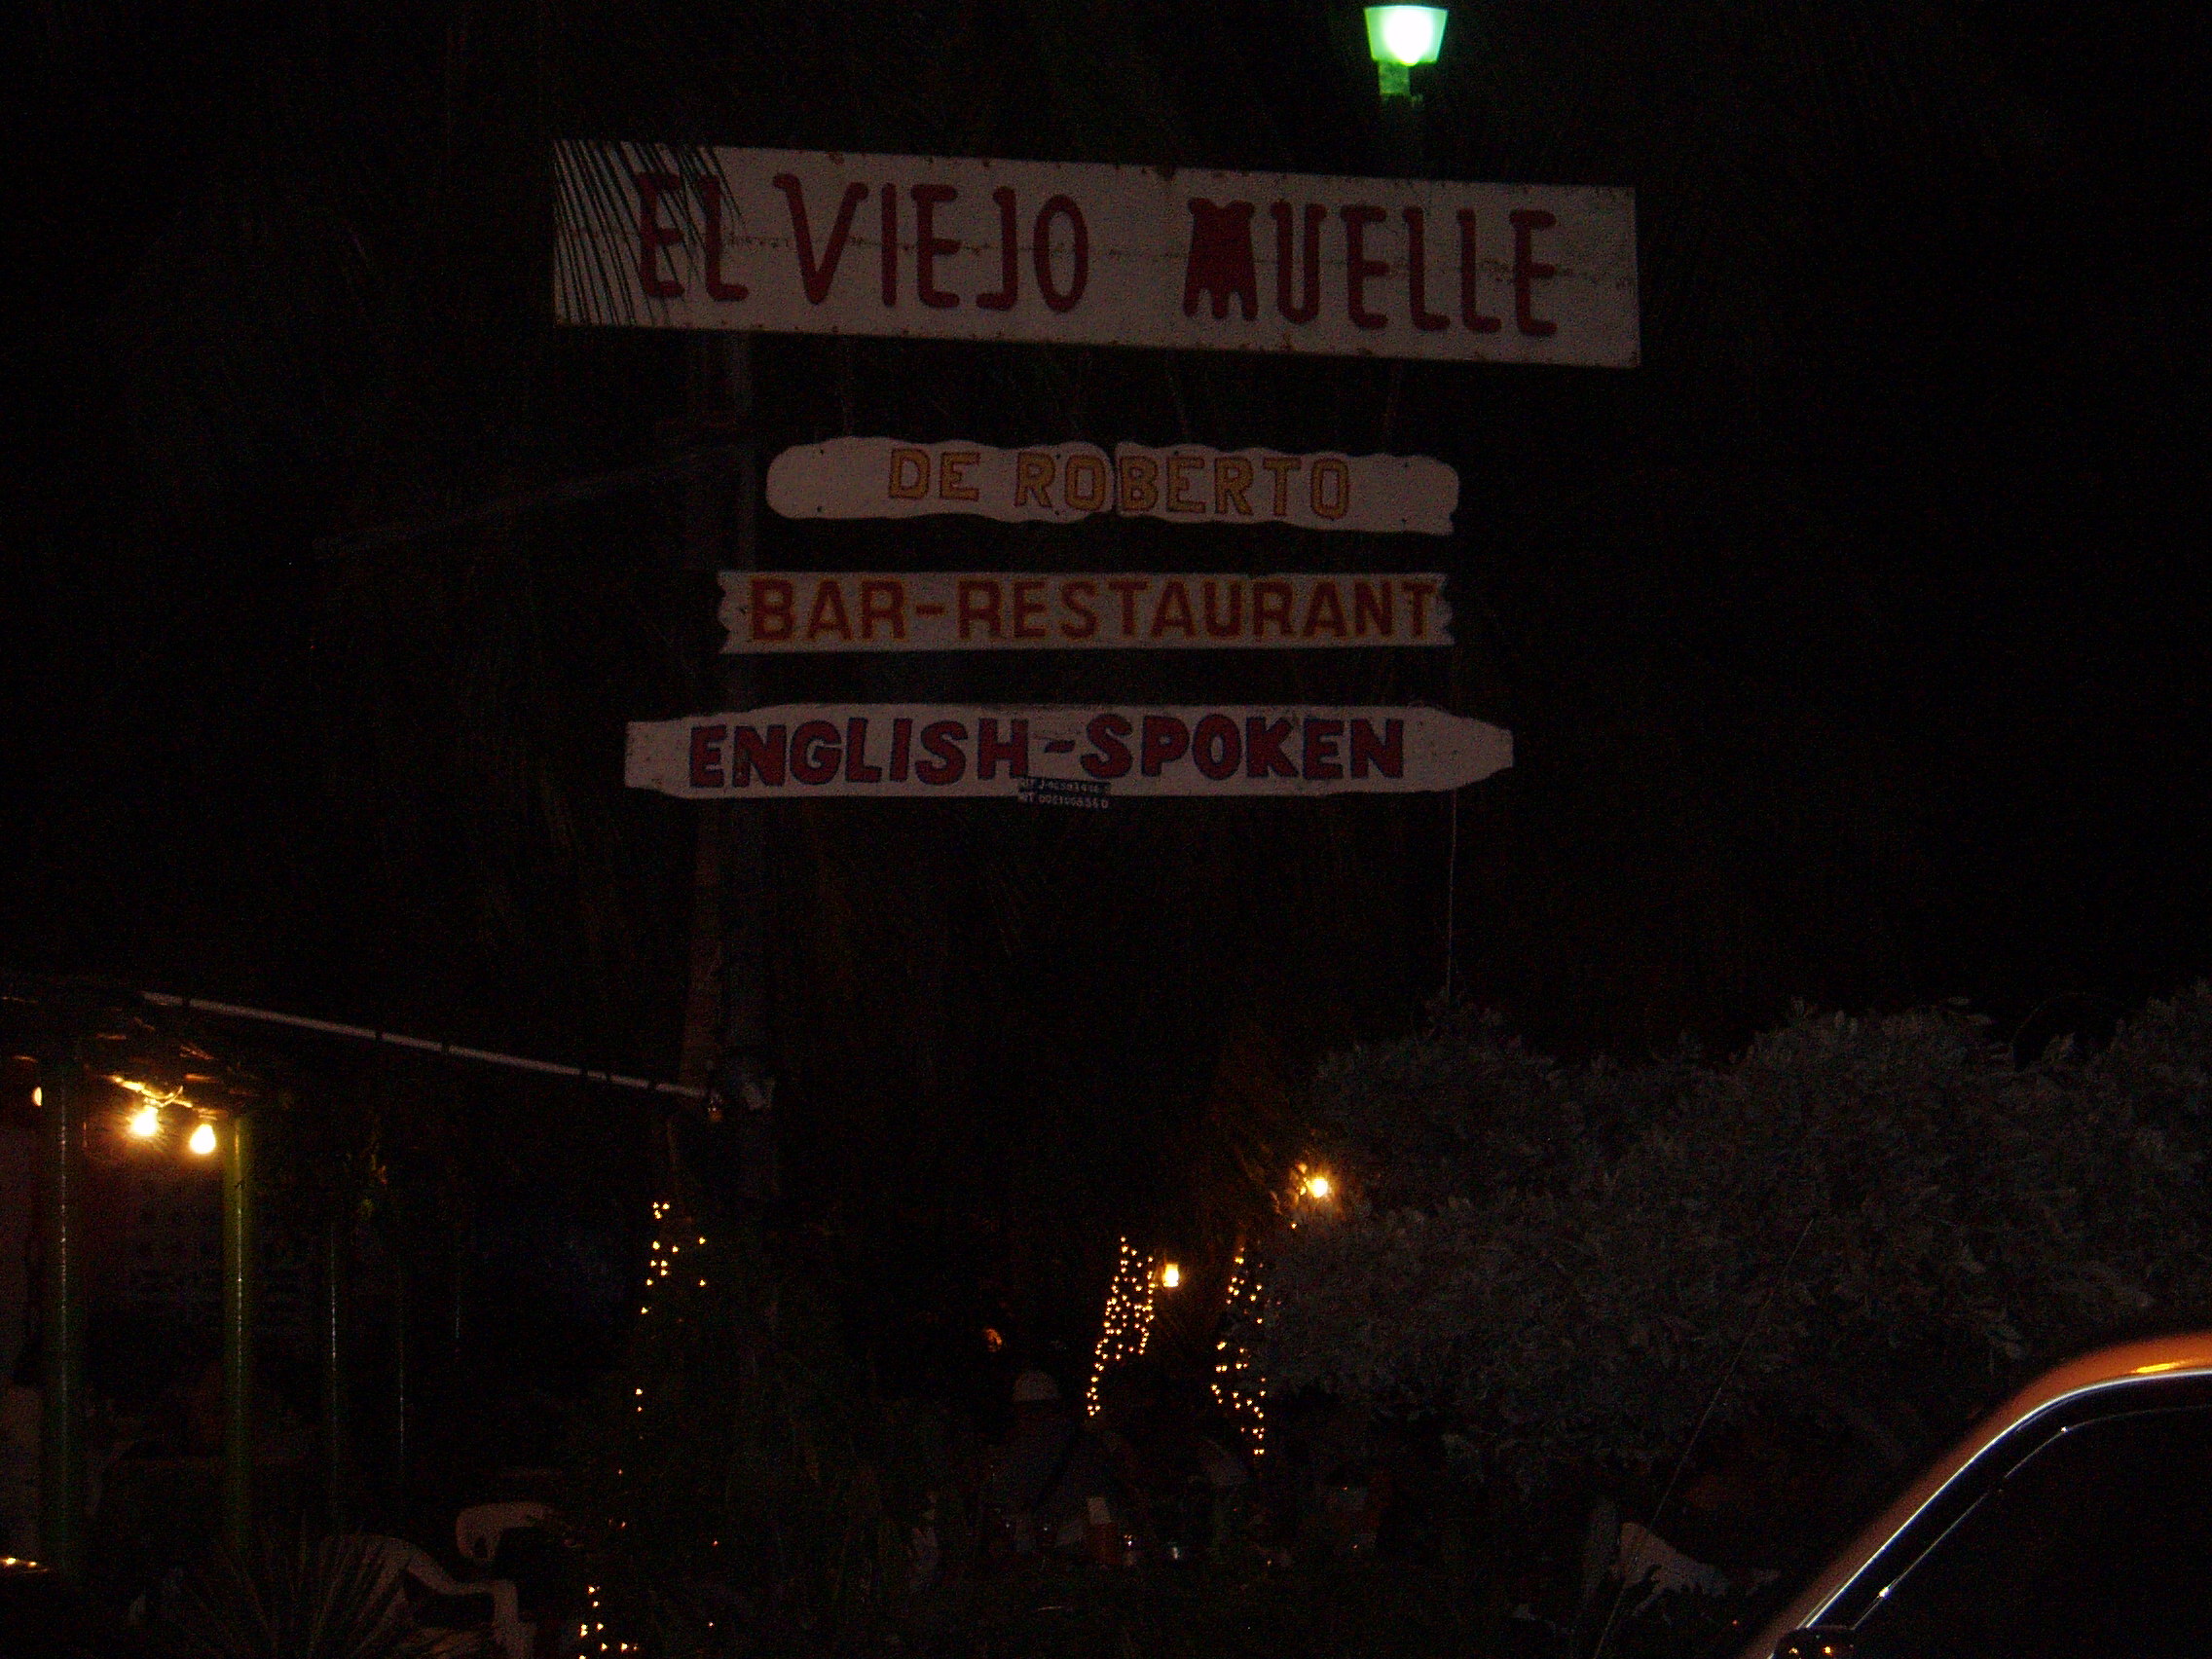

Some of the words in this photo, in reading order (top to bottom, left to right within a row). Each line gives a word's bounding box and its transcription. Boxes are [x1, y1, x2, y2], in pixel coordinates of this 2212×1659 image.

[635, 171, 749, 301] EL
[773, 172, 1088, 313] VIEJO
[1182, 198, 1557, 336] MUELLE
[888, 447, 980, 501] DE
[1014, 451, 1349, 521] ROBERTO
[749, 576, 1437, 641] BAR-RESTAURANT
[688, 714, 1404, 788] ENGLISH-SPOKEN
